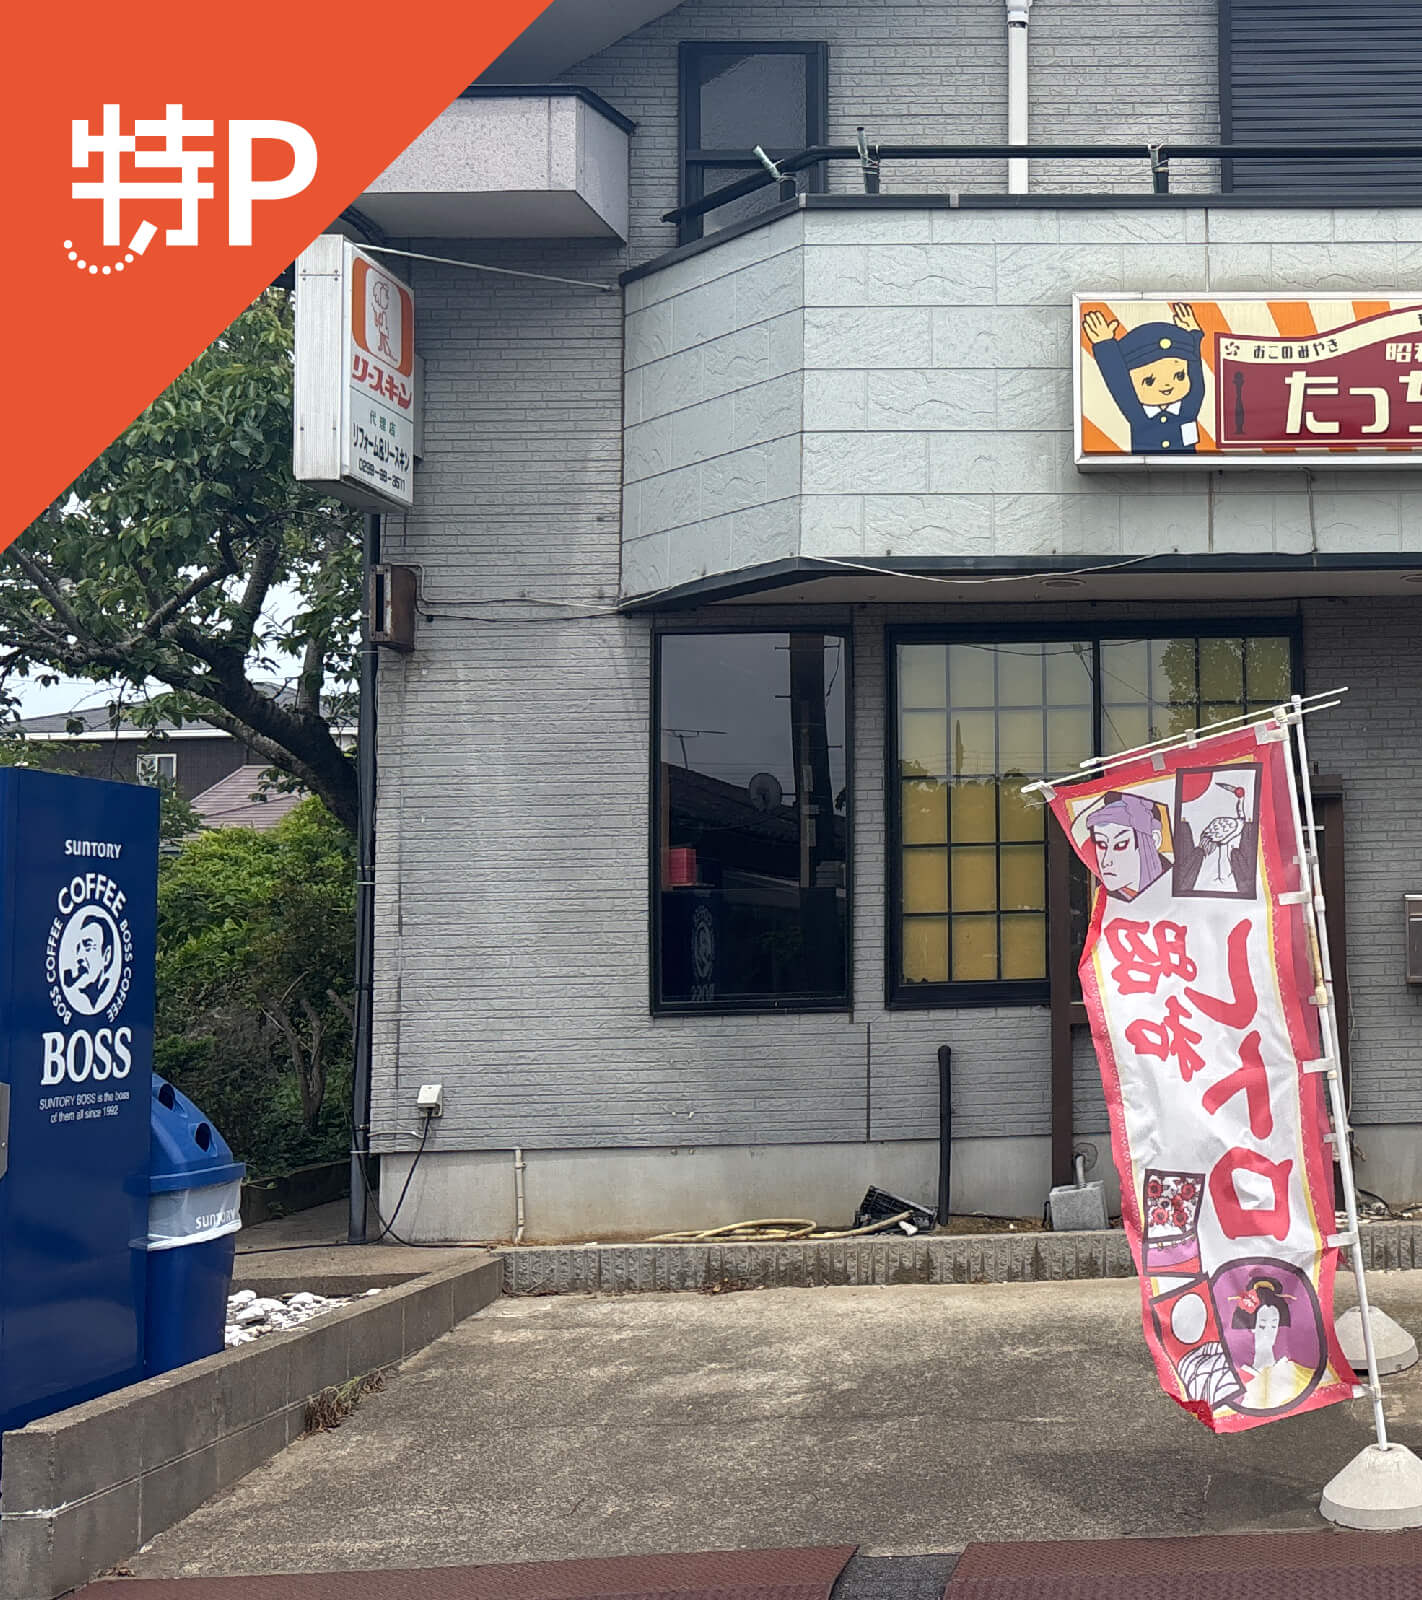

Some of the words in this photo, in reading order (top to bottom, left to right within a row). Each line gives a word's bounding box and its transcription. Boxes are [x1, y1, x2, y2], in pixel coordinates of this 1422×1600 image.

[1253, 338, 1339, 359] おこのみやき
[352, 354, 412, 410] リースキン
[369, 409, 396, 438] 代理店
[64, 839, 122, 859] SUNTORY
[58, 873, 127, 918] COFFEE
[46, 917, 63, 983] COFFEE
[119, 918, 133, 962] BOSS
[50, 985, 72, 1026] BOSS
[106, 967, 132, 1023] COFFEE
[41, 1027, 131, 1085] BOSS
[39, 1096, 75, 1110] SUNTORY
[76, 1092, 96, 1106] BOSS
[50, 1111, 58, 1124] of
[58, 1110, 74, 1122] them
[76, 1109, 84, 1120] all
[85, 1108, 101, 1119] since
[103, 1105, 119, 1116] 1992
